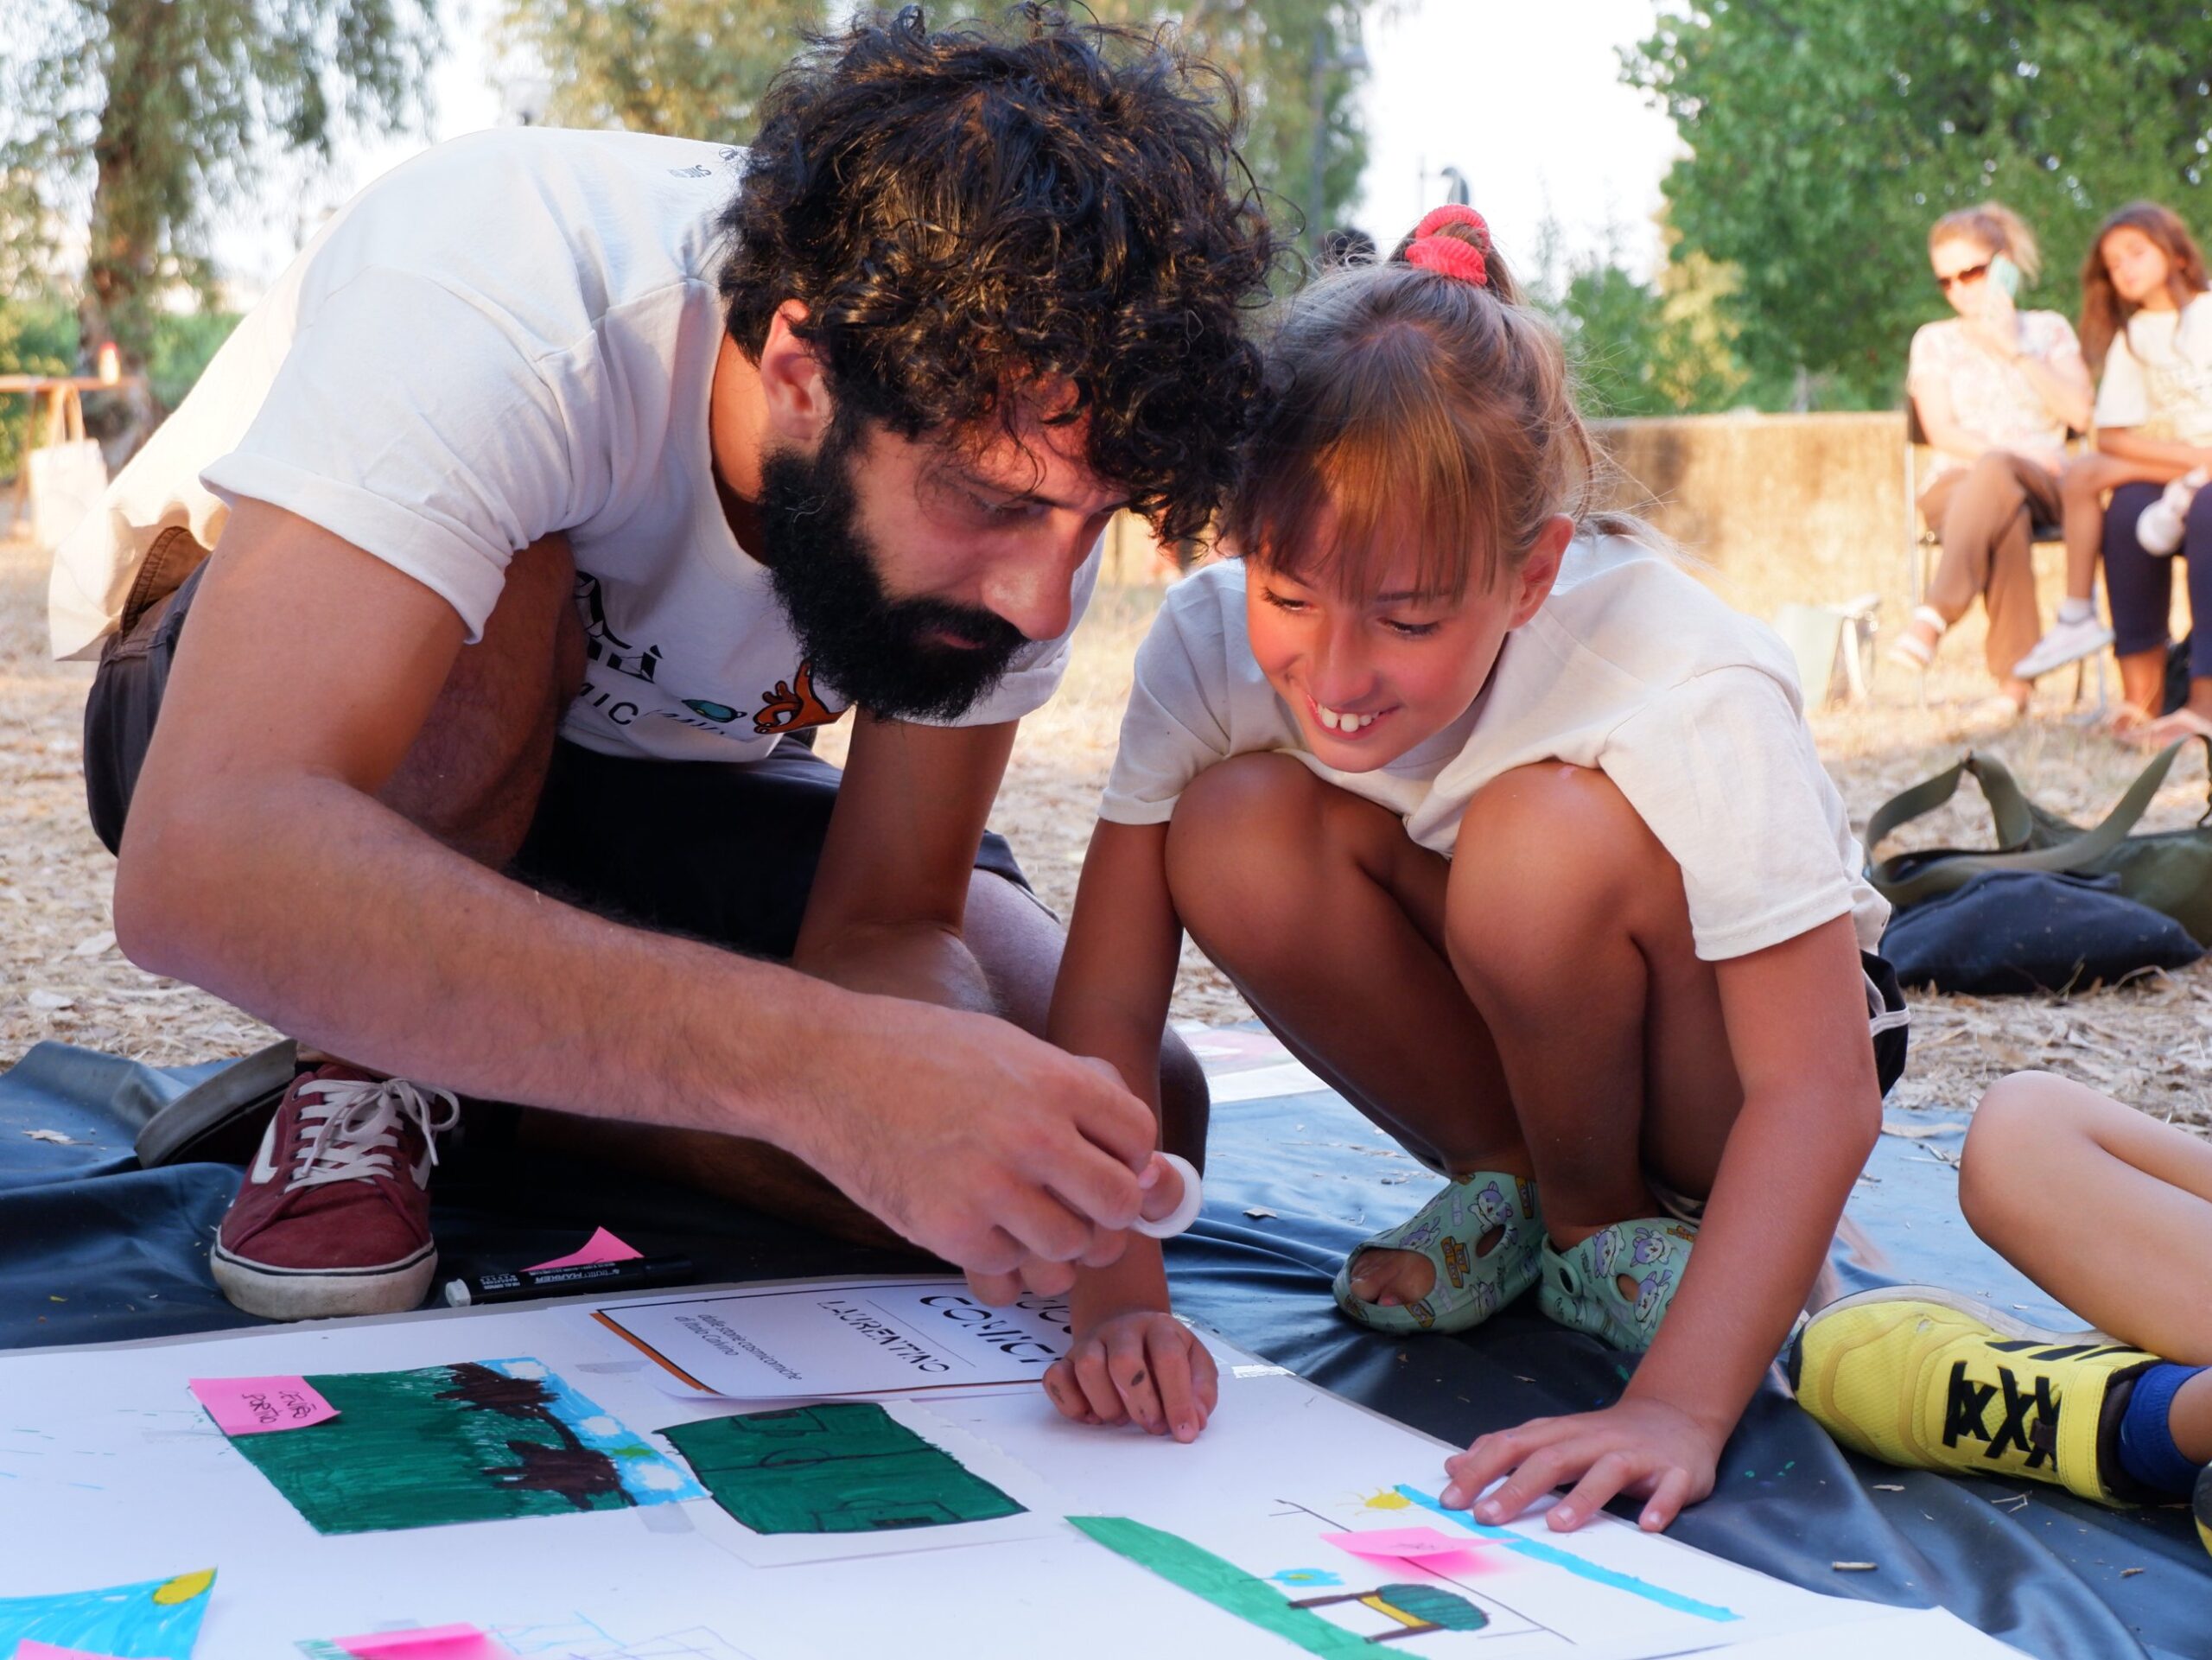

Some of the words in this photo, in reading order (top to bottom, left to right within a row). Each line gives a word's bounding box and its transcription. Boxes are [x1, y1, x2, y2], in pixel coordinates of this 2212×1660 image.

[702, 1334, 739, 1356] Calvino
[817, 1300, 950, 1372] LAURENTINO
[919, 1295, 1065, 1364] COMICI
